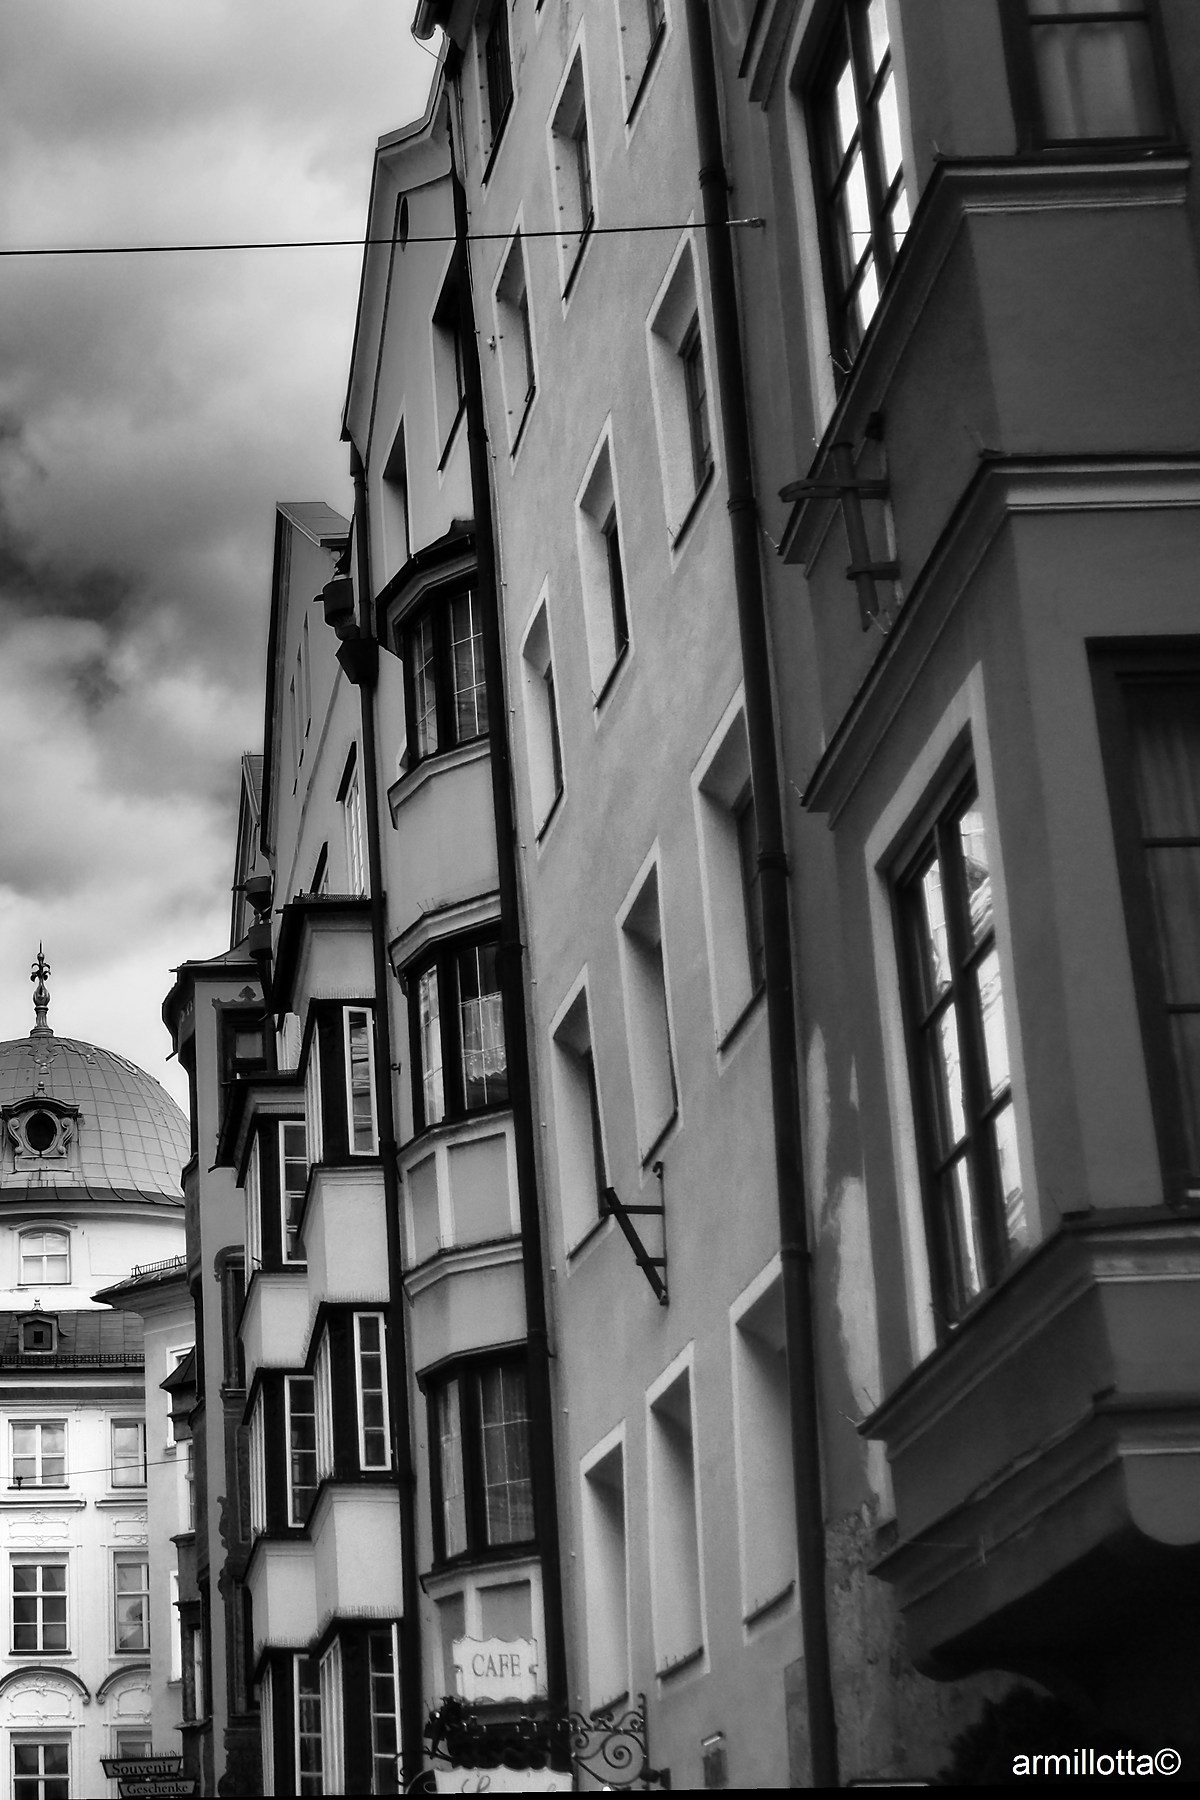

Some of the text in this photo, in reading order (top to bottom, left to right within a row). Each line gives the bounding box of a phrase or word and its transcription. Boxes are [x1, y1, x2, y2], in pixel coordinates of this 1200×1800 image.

[471, 1653, 521, 1677] CAFE
[112, 1761, 174, 1775] Souvenir
[126, 1782, 189, 1795] Geschenke
